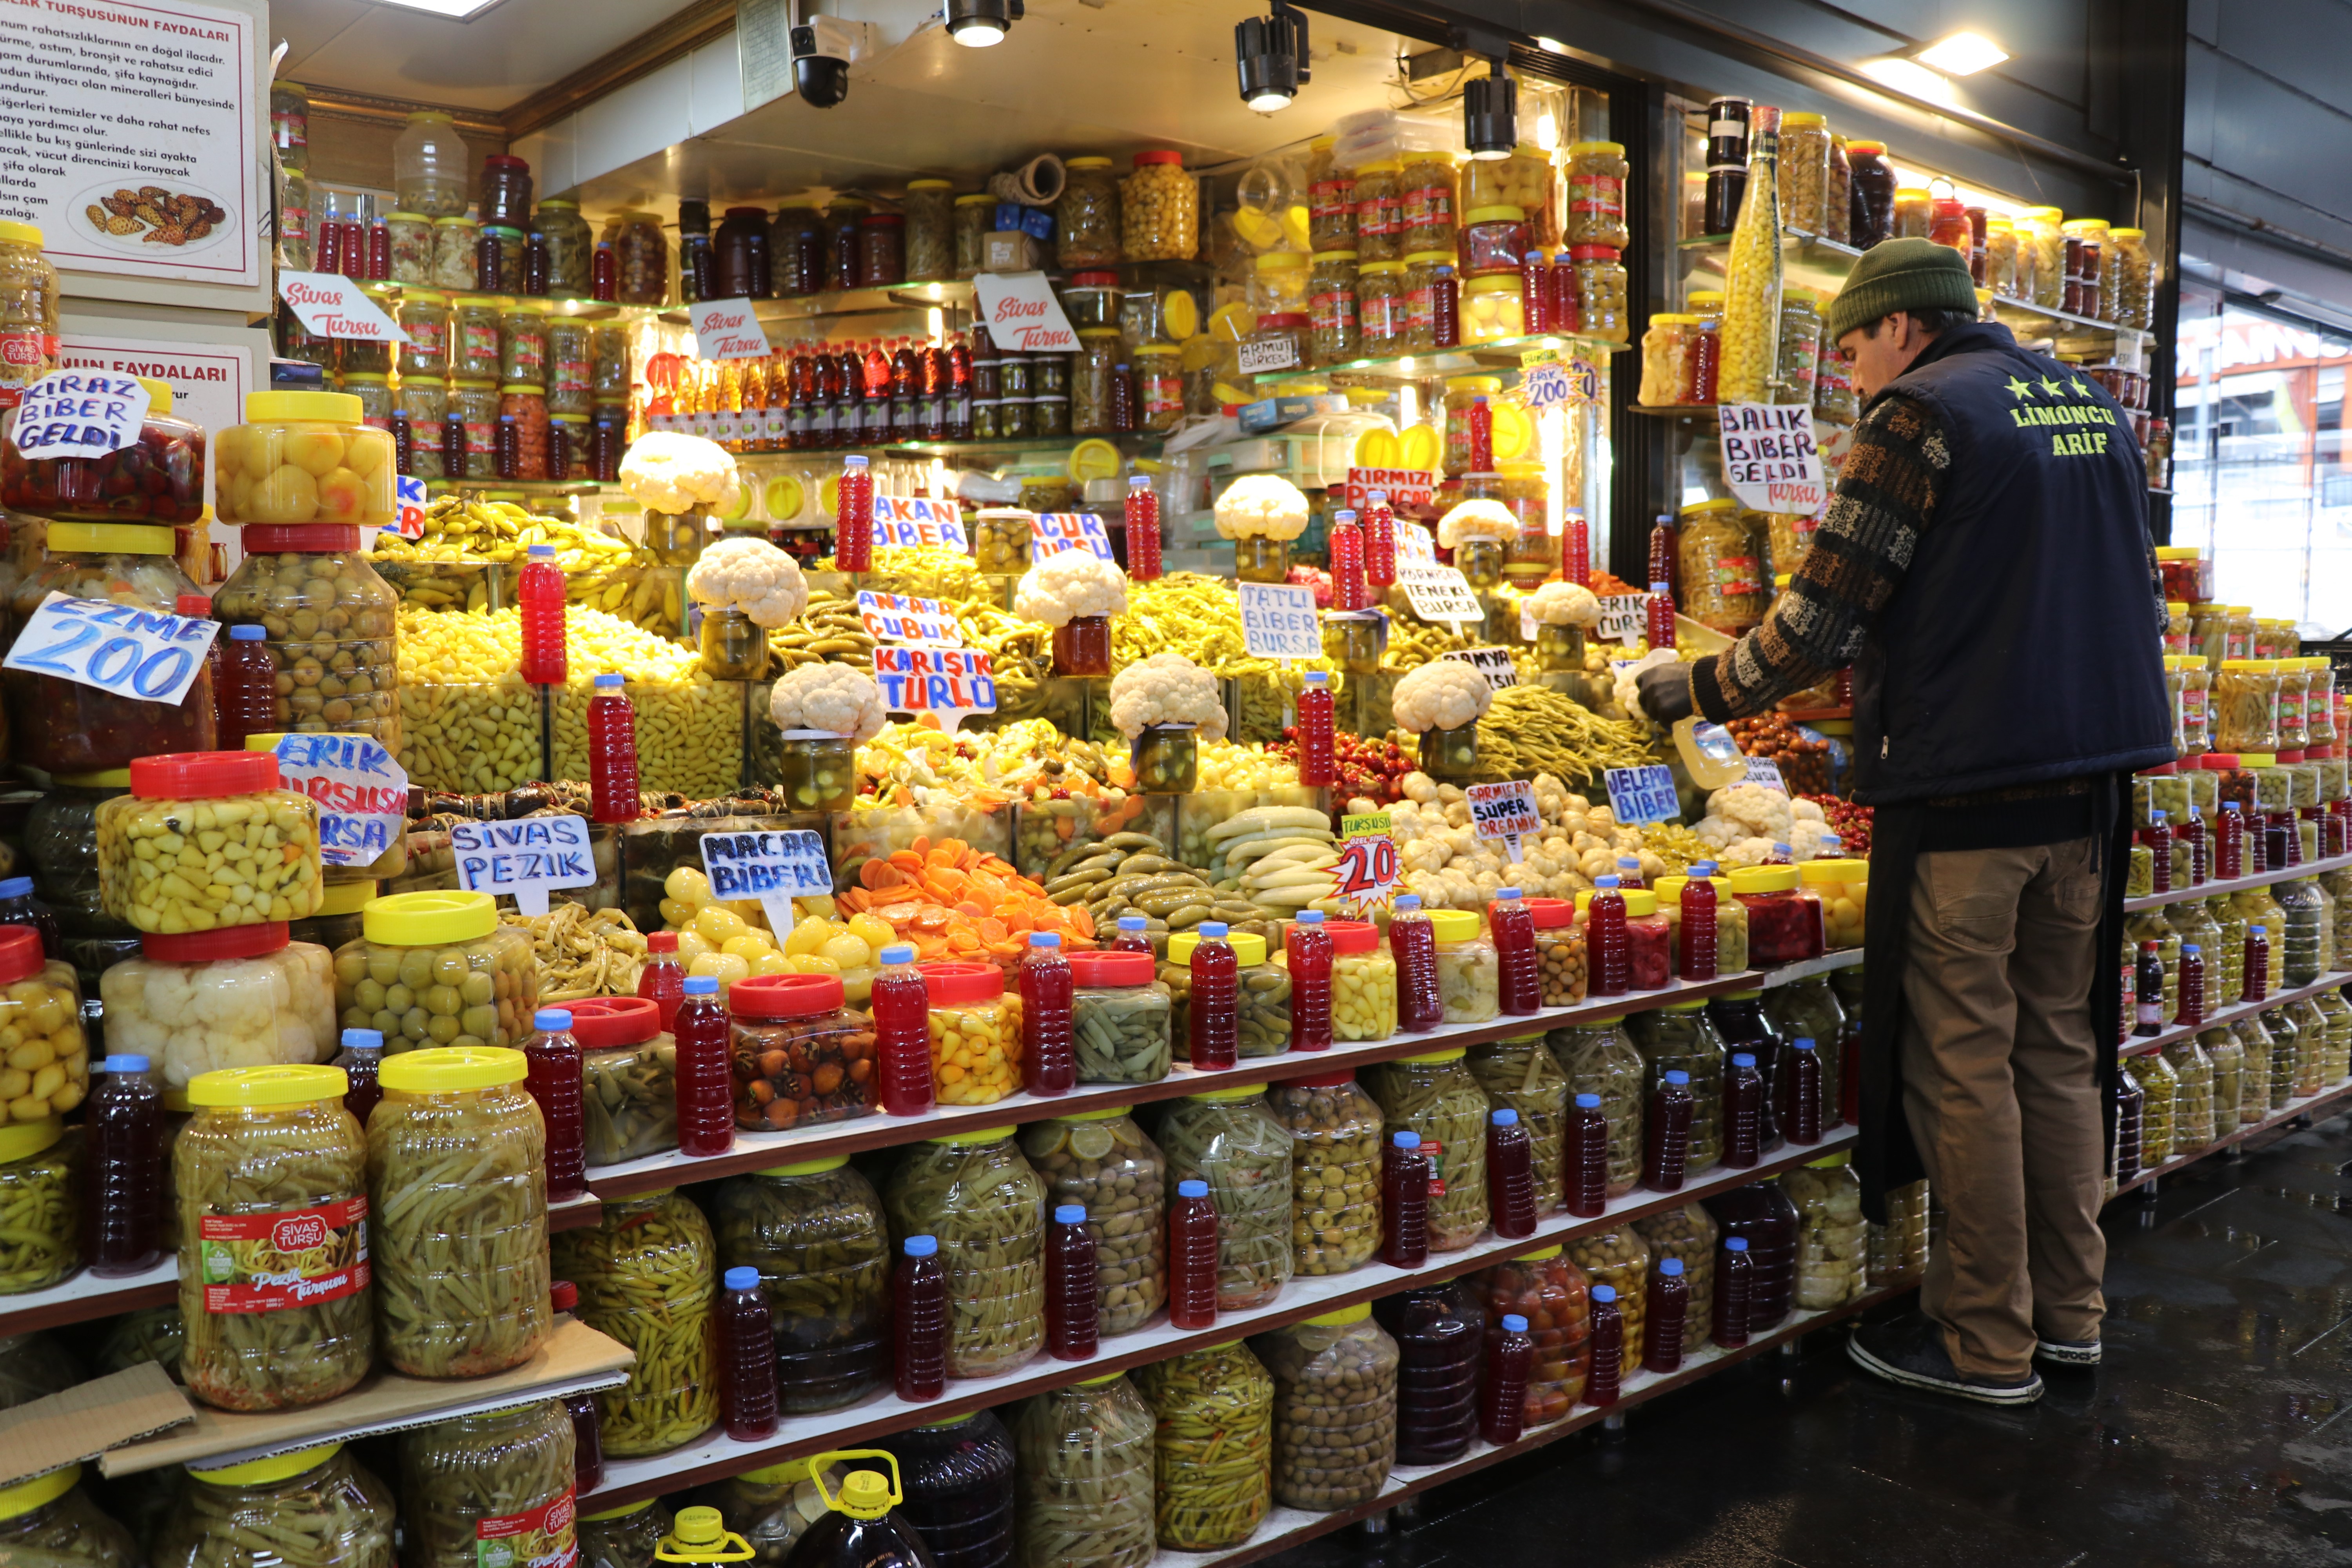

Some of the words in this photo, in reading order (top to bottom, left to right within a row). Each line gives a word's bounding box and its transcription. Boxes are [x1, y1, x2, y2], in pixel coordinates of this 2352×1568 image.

[45, 1, 149, 28] TURŞUSUNUN
[154, 21, 229, 42] FAYDALARI
[32, 25, 131, 49] rahatsızlıklarının
[152, 45, 183, 58] doğal
[186, 50, 225, 65] ilacıdır.
[27, 54, 110, 78] durumlarında,
[115, 69, 135, 80] şifa
[139, 72, 199, 90] kaynağıdır.
[40, 44, 76, 56] astım,
[80, 47, 120, 64] bronşit
[140, 59, 185, 73] rahatsız
[188, 66, 213, 77] edici
[35, 71, 78, 85] ihtiyacı
[82, 79, 107, 91] olan
[111, 85, 172, 101] mineralleri
[175, 93, 235, 110] bünyesinde
[0, 97, 45, 112] iğerleri
[49, 105, 98, 120] temizler
[100, 114, 113, 122] ve
[117, 114, 145, 126] daha
[149, 120, 179, 131] rahat
[182, 125, 211, 136] nefes
[28, 119, 79, 132] yardımcı
[83, 125, 108, 136] olur.
[36, 132, 51, 144] bu
[55, 135, 71, 149] kış
[75, 140, 136, 155] günlerinde
[140, 148, 157, 158] sizi
[160, 152, 197, 163] ayakta
[3, 160, 24, 172] şifa
[28, 164, 66, 176] olarak
[35, 150, 67, 161] vücut
[71, 153, 130, 169] direncinizi
[134, 161, 191, 177] koruyacak
[24, 195, 48, 205] çam
[286, 282, 343, 308] Sivas
[700, 311, 746, 335] Sivas
[994, 296, 1048, 323] Sivas
[312, 313, 381, 338] Turşu
[1013, 325, 1073, 352] Turşu
[7, 352, 38, 363] TURŞU
[8, 344, 36, 353] SİVAS
[1240, 339, 1290, 357] ARMUT
[0, 378, 25, 390] ezik
[113, 361, 227, 381] FAYDALARI
[23, 375, 136, 405] KİRAZ
[1529, 379, 1566, 406] 200
[20, 396, 128, 425] BİBER
[1721, 407, 1808, 433] BALIK
[2009, 403, 2117, 427] LİMONCU
[17, 423, 122, 452] GELDİ
[2053, 427, 2107, 456] ARİF
[1348, 468, 1433, 486] KIRMIZI
[1730, 459, 1807, 483] GELDİ
[873, 516, 965, 546] BİBER
[858, 591, 957, 618] ANKARA
[1241, 585, 1308, 608] TATLI
[1406, 584, 1468, 598] TENEKE
[44, 595, 218, 644] EZME
[1416, 599, 1480, 614] BURSA
[862, 612, 961, 641] ÇUBUK
[1245, 606, 1317, 635] BİBER
[1249, 630, 1319, 654] BURSA
[13, 618, 194, 699] 200
[875, 648, 993, 677] KARIŞIK
[878, 672, 996, 710] TÜRLÜ
[277, 733, 391, 778] ERİK
[1474, 798, 1529, 821] SÜPER
[320, 813, 387, 851] RSA
[452, 819, 580, 851] SİVAS
[1343, 817, 1391, 834] TURŞUSU
[704, 831, 826, 864] MACAR
[1350, 835, 1368, 846] ÖZEL
[1340, 840, 1396, 893] 20
[279, 1231, 322, 1247] TURŞU
[281, 1221, 319, 1236] SİVAS
[250, 1268, 306, 1292] Pezik
[287, 1274, 348, 1301] Turşusu
[549, 1511, 571, 1530] TURŞU
[551, 1501, 570, 1521] SİVAS
